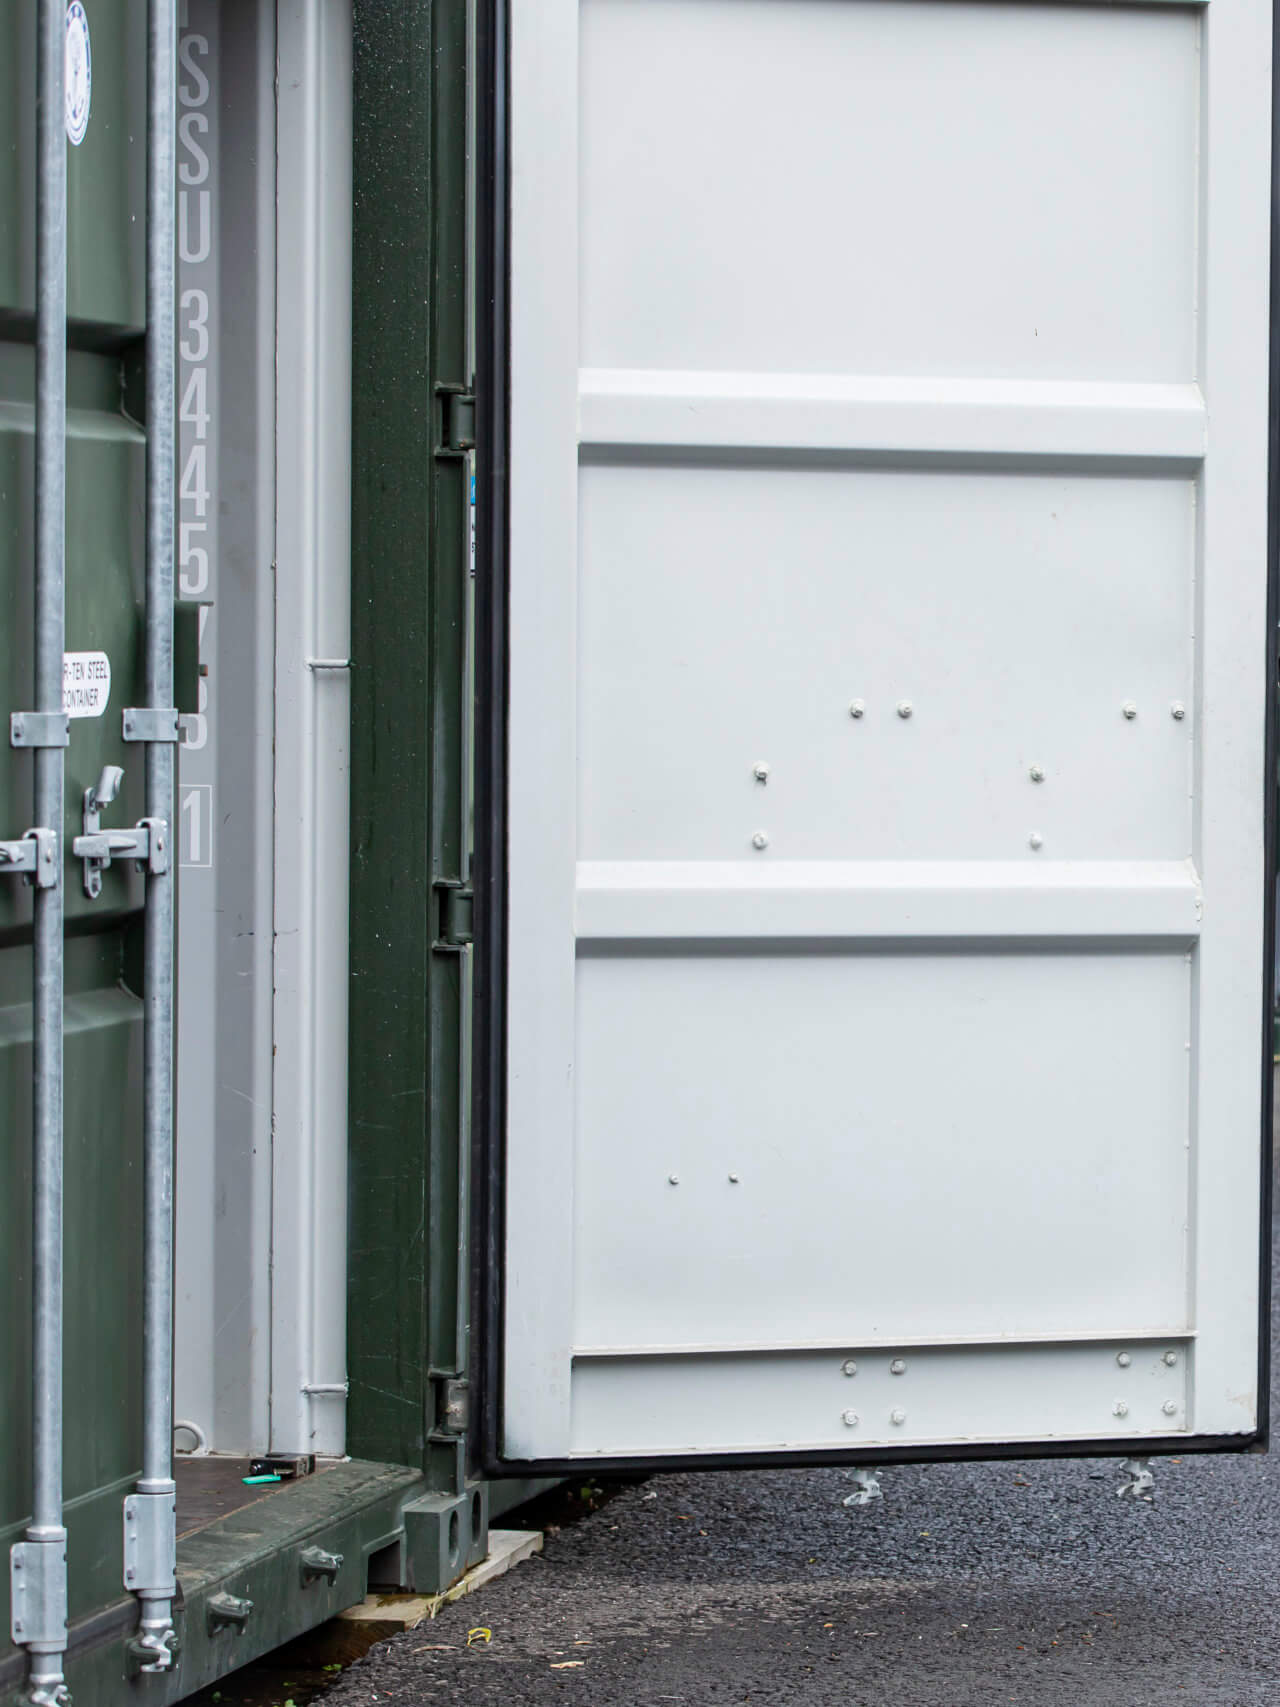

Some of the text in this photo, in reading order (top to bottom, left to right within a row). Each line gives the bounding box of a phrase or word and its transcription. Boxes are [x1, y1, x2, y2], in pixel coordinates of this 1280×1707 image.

[179, 289, 210, 750] 34453
[64, 661, 107, 680] R-TEN STEEL
[183, 790, 201, 862] 1
